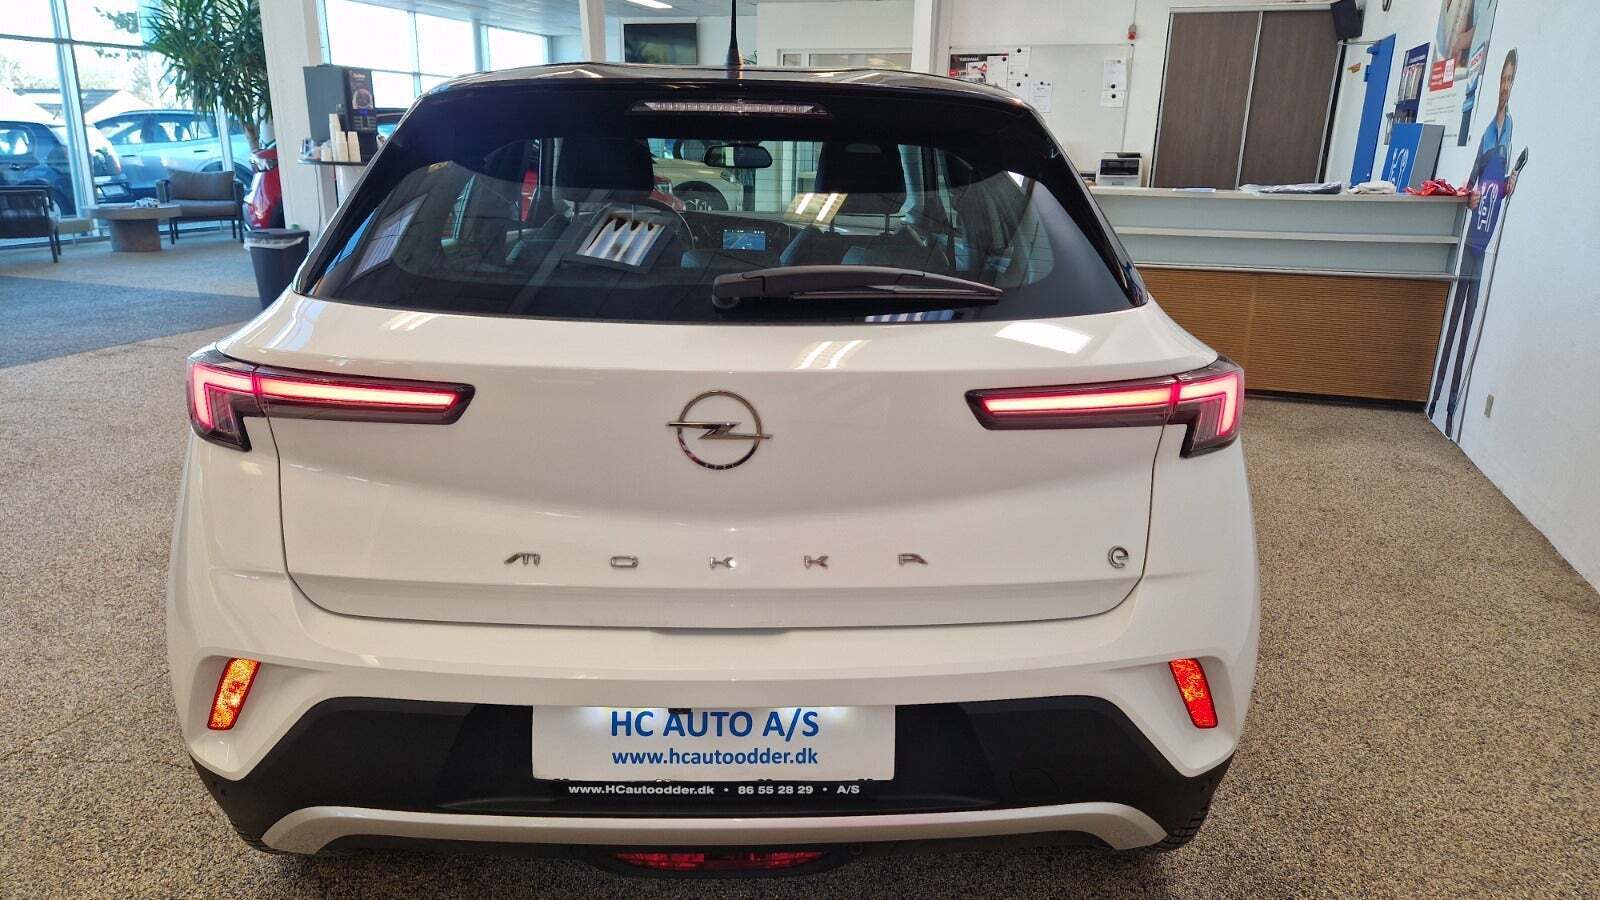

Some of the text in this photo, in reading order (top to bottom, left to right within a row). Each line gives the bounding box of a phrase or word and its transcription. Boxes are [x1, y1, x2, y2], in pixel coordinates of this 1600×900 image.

[610, 707, 820, 742] HC AUTO A/S
[611, 748, 819, 765] www.hcautoodder.dk
[568, 784, 861, 795] www.HCautoodder.dk 86 55 28 29 A/S
